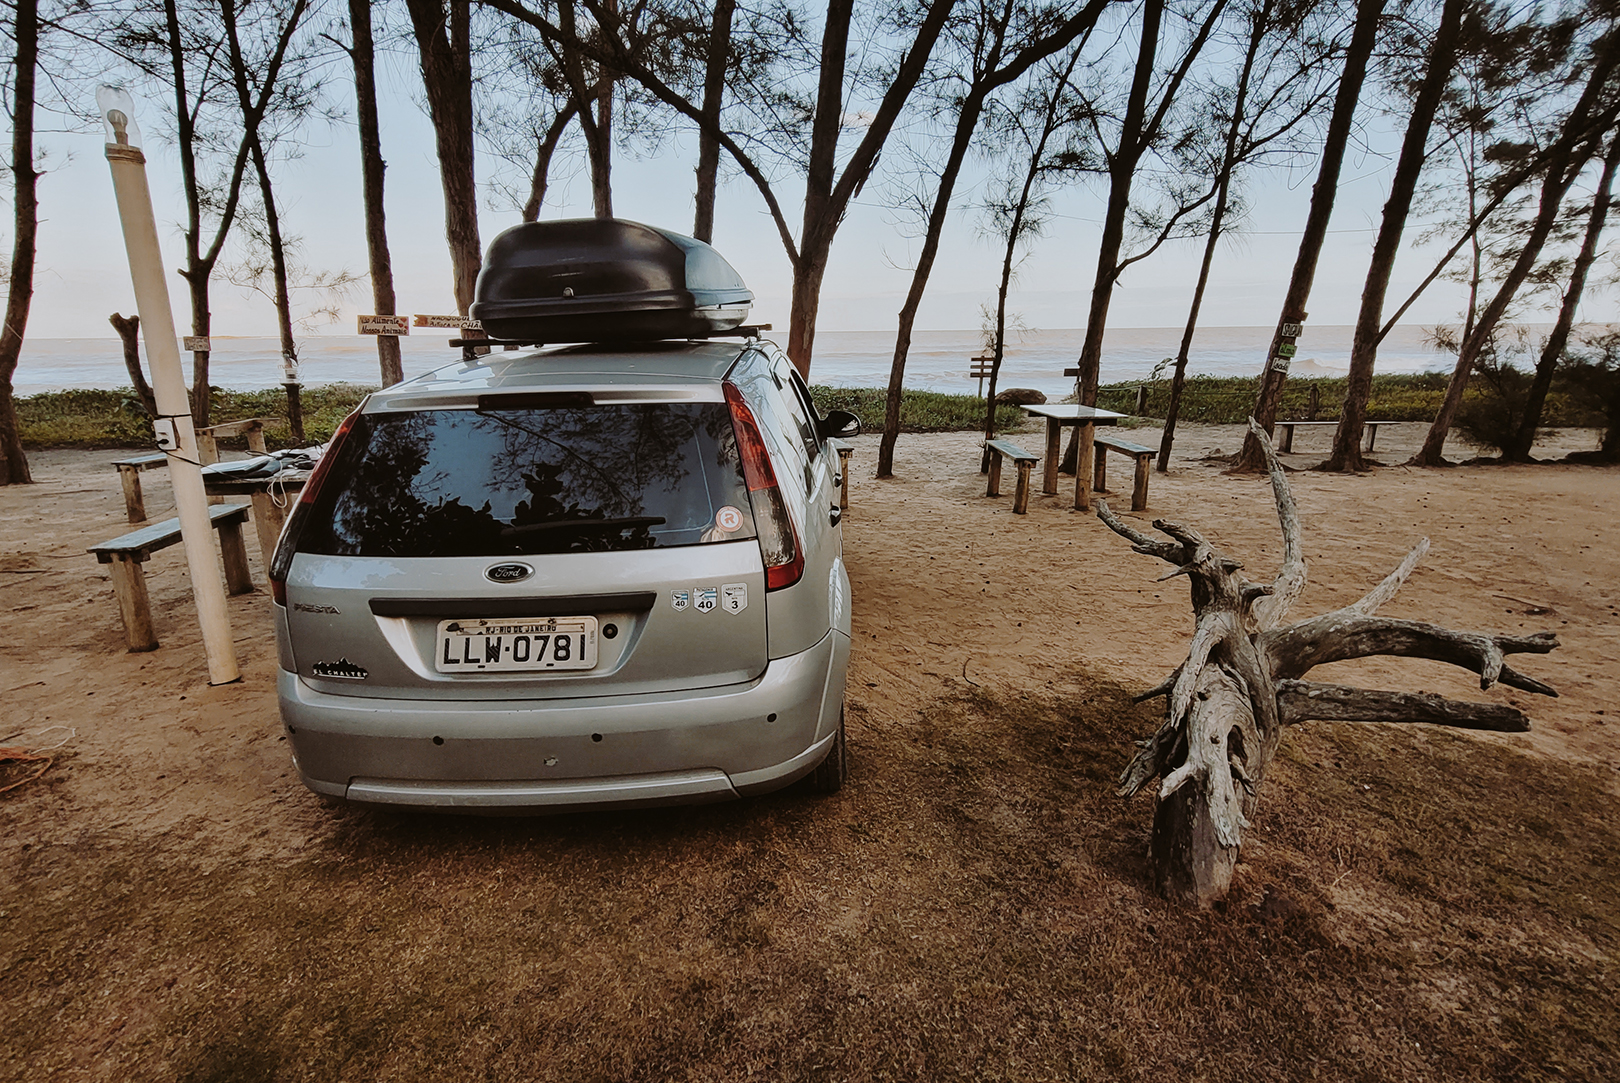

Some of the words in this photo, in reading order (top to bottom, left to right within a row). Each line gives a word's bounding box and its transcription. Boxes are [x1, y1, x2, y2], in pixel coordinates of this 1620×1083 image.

[371, 316, 399, 324] Alimente
[361, 325, 380, 334] Nossos
[381, 325, 408, 334] Animais
[495, 566, 522, 578] Ford
[698, 600, 712, 608] 40
[732, 600, 738, 609] 3
